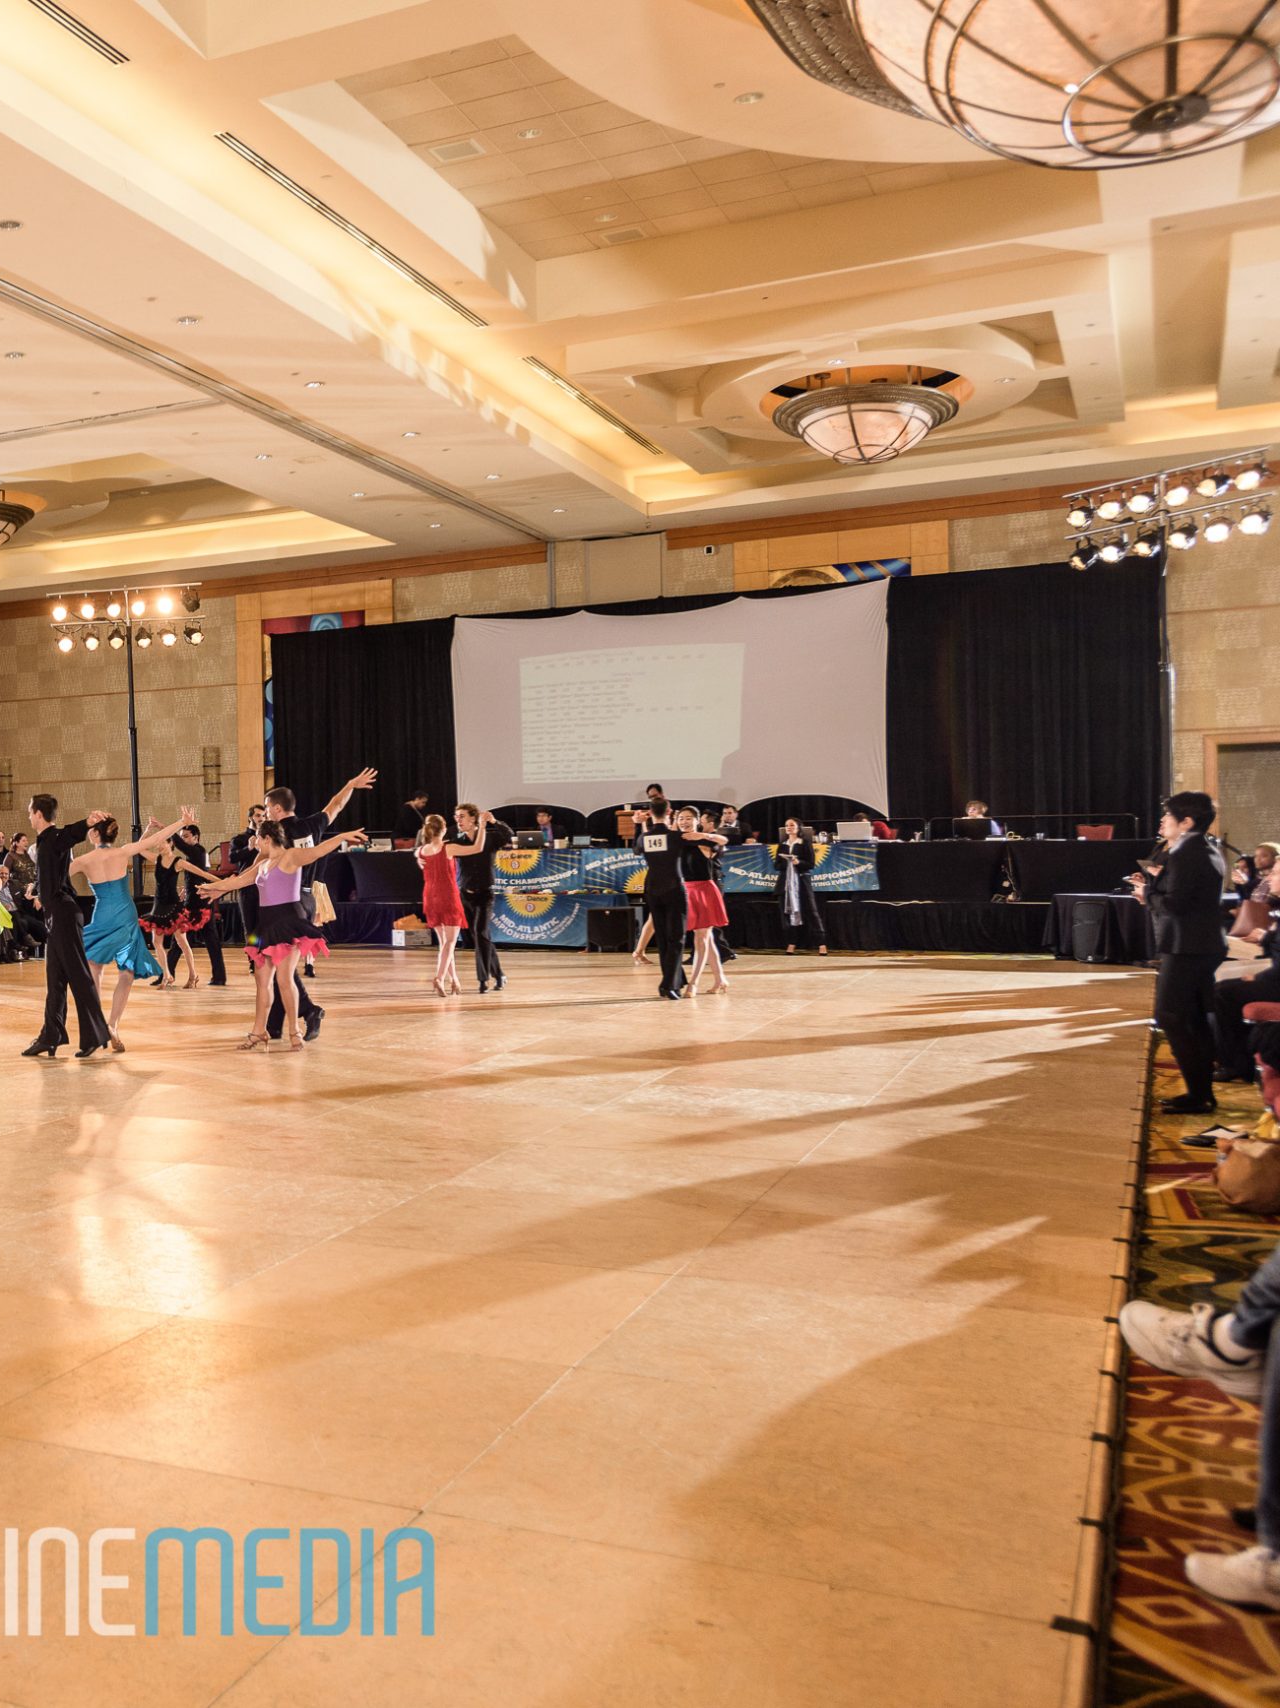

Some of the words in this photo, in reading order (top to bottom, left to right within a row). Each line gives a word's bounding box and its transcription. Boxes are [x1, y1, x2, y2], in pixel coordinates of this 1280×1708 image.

[647, 838, 663, 848] 149
[728, 866, 779, 881] MID-ATLAN
[499, 914, 560, 934] MID-ATLANTIC
